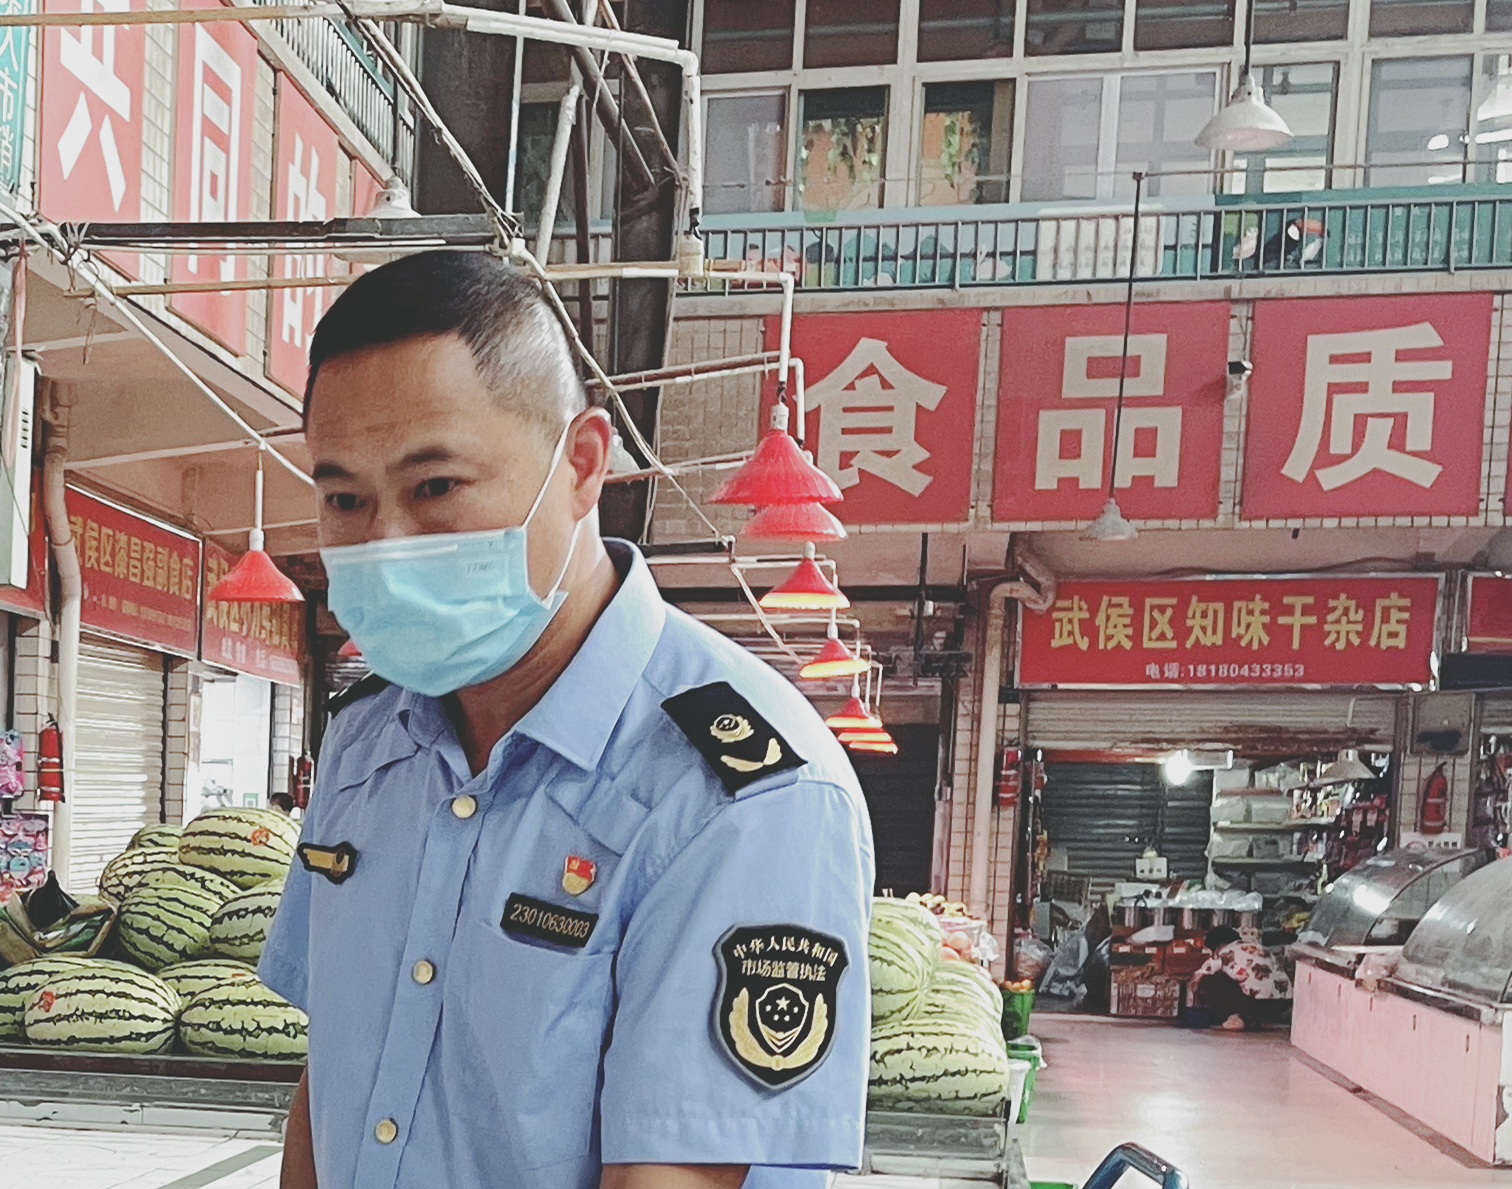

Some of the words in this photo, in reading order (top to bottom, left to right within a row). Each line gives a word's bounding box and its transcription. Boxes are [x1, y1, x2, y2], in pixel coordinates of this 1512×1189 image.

[806, 322, 1453, 497] 食品质
[1050, 592, 1412, 651] 武侯区知味干杂店
[510, 903, 590, 939] 23010630003
[733, 935, 839, 968] 中华人民共和国
[741, 958, 827, 982] 市场监管执法
